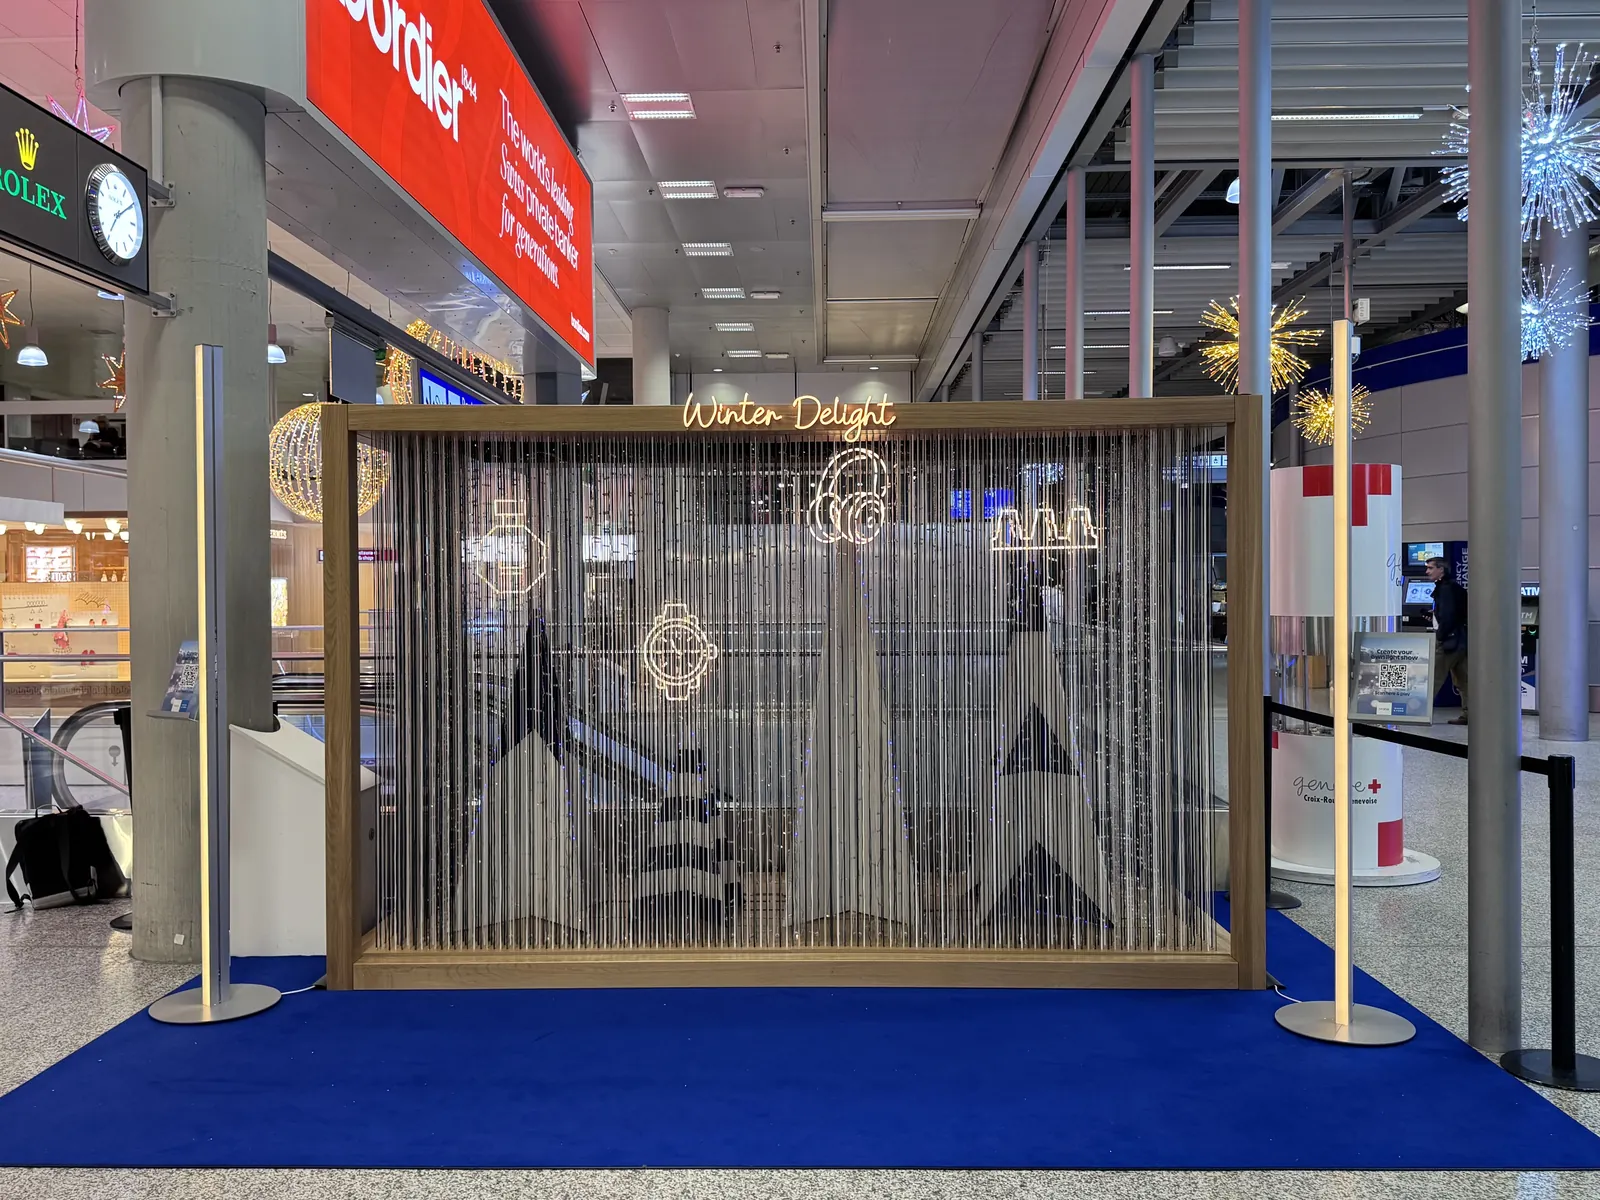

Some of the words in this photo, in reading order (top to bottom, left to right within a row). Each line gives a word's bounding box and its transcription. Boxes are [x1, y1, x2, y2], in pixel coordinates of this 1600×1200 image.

[339, 0, 463, 143] ordier
[461, 64, 477, 103] 1844
[0, 166, 67, 220] OLEX
[499, 88, 519, 148] The
[520, 130, 551, 193] world's
[551, 167, 575, 237] leading
[500, 142, 525, 203] Swiss
[526, 183, 555, 241] private
[554, 215, 579, 271] banker
[499, 193, 516, 239] for
[515, 221, 560, 290] generations.
[683, 392, 782, 429] Winter
[792, 393, 896, 443] Delight
